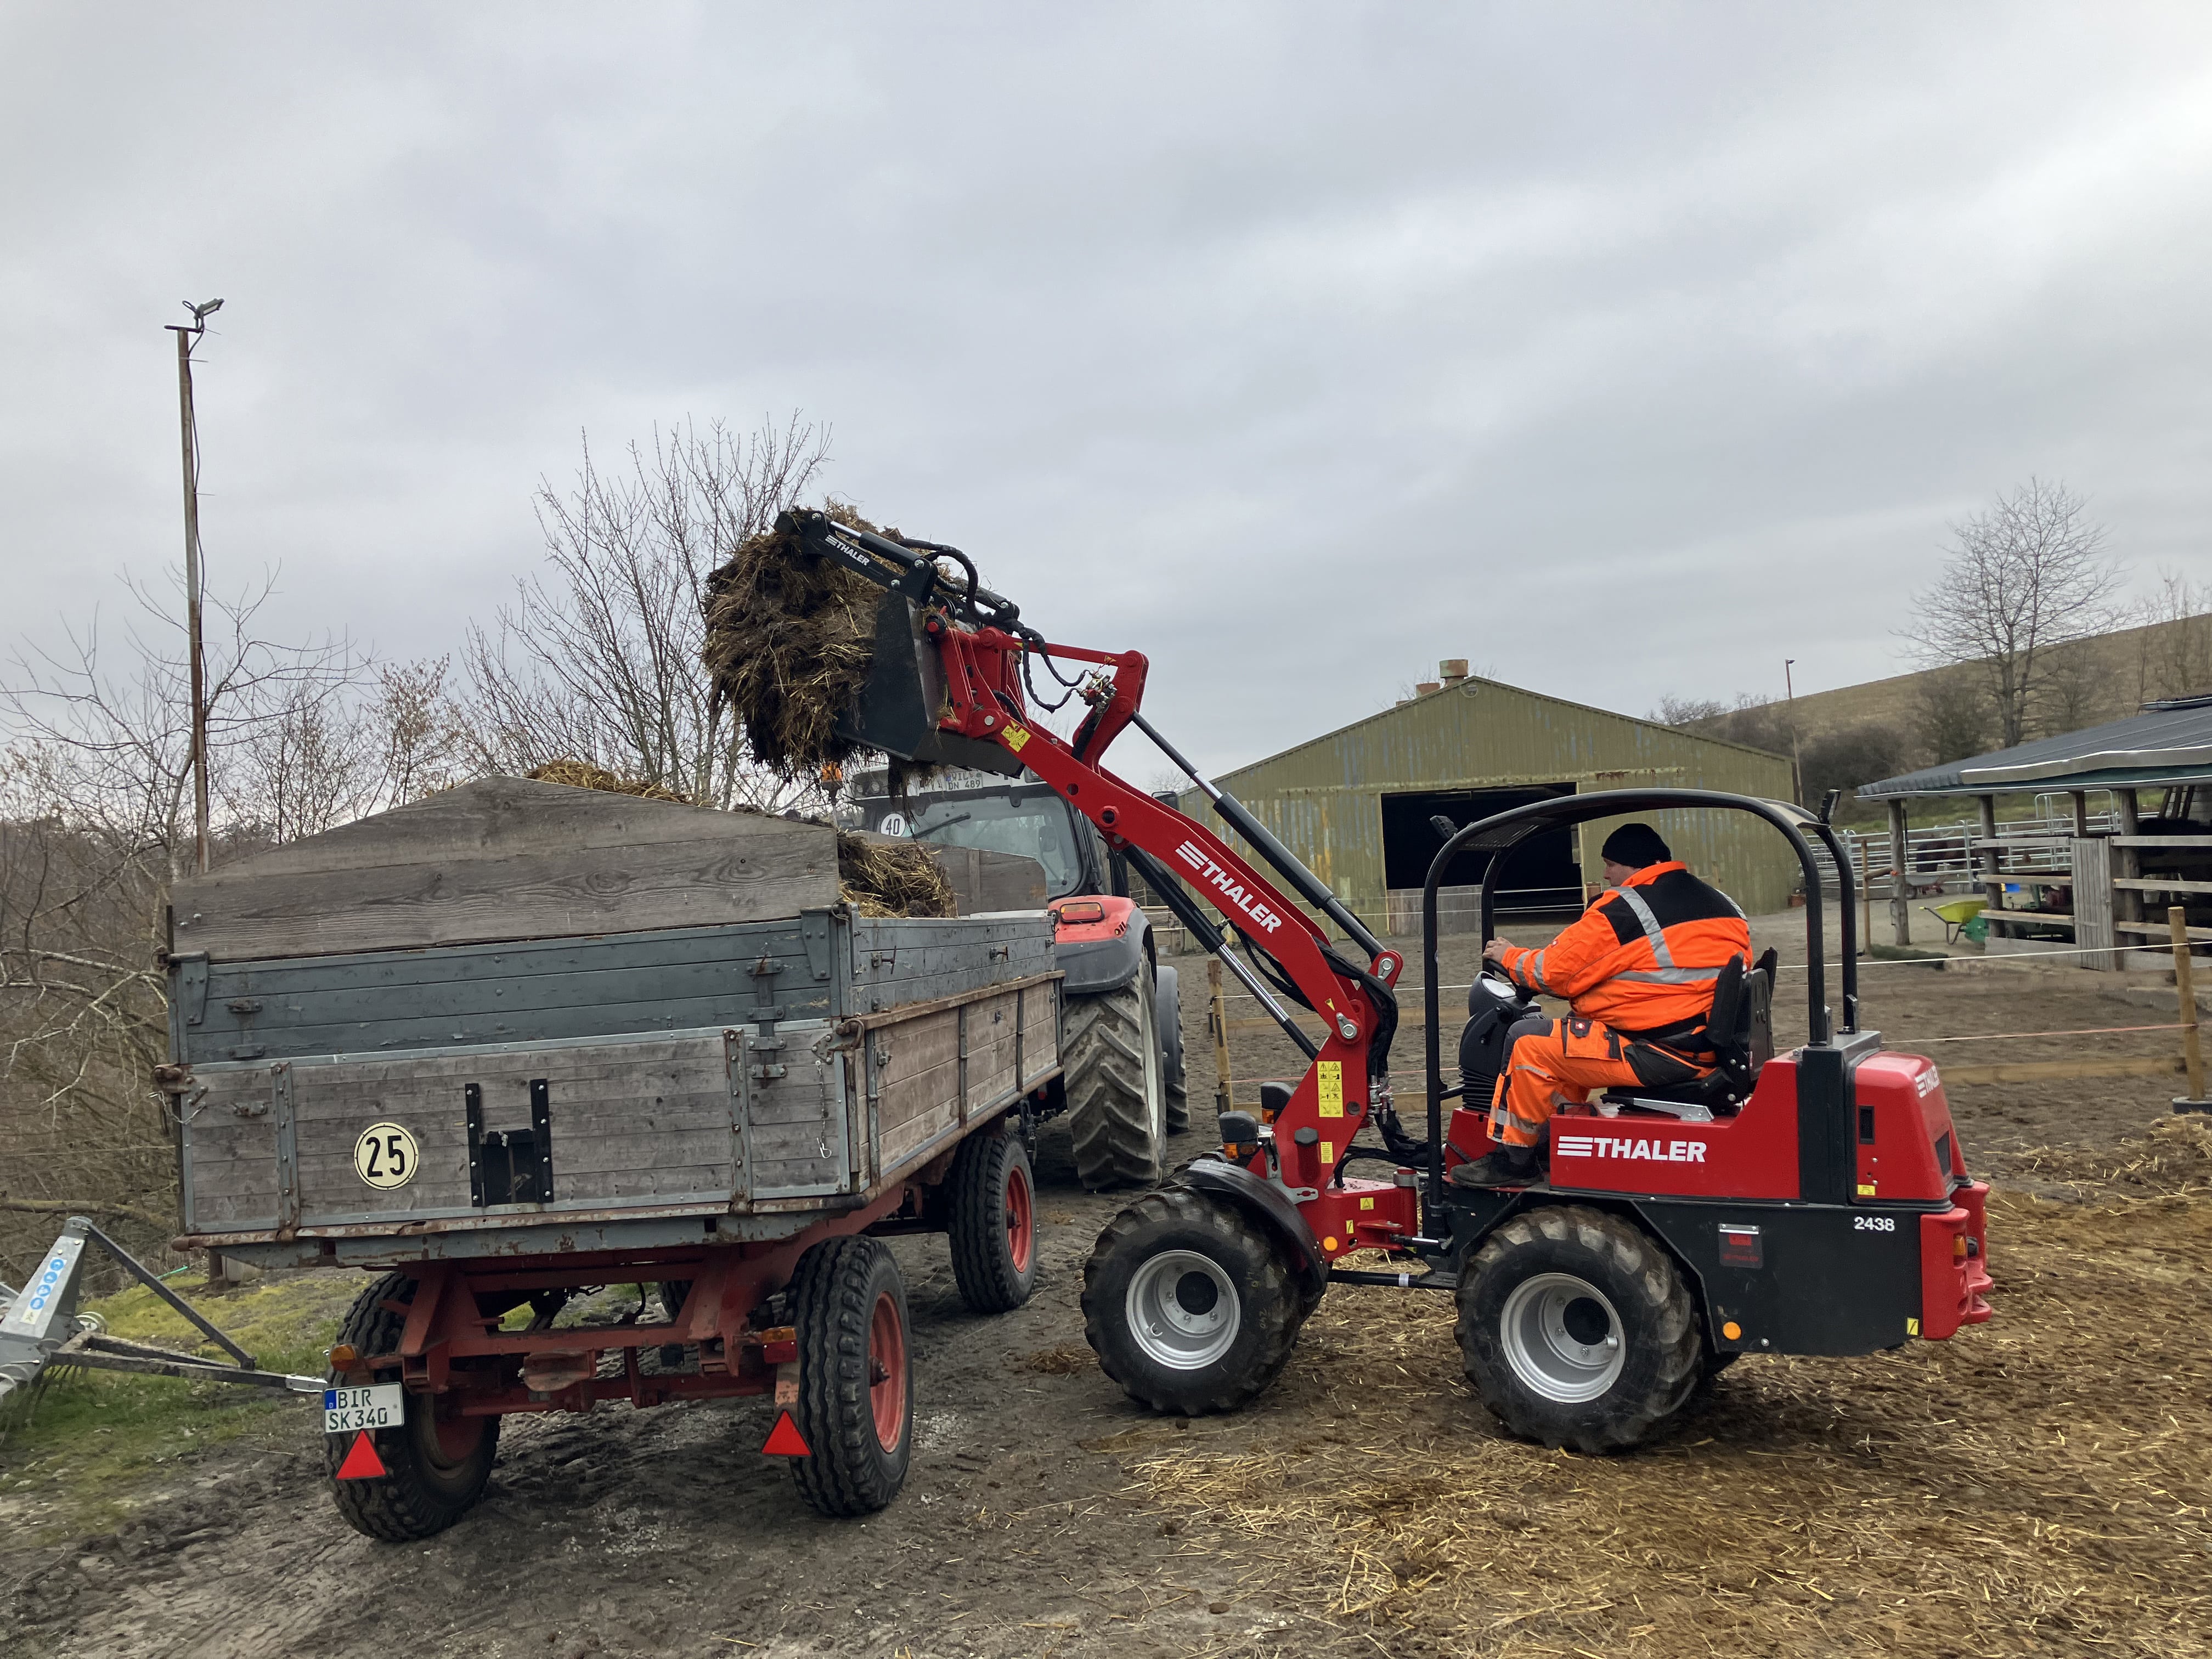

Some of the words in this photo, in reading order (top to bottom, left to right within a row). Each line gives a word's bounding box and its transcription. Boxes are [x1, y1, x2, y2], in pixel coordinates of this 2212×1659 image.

[837, 541, 870, 566] THALER
[948, 782, 959, 790] DN
[964, 780, 980, 788] 489
[952, 772, 968, 782] WIL
[885, 818, 900, 835] 40
[1202, 860, 1282, 934] THALER
[366, 1135, 405, 1177] 25
[1594, 1137, 1707, 1163] THALER
[1854, 1216, 1895, 1232] 2438
[338, 1389, 372, 1409] BIR
[329, 1411, 351, 1430] SK
[355, 1407, 387, 1427] 340
